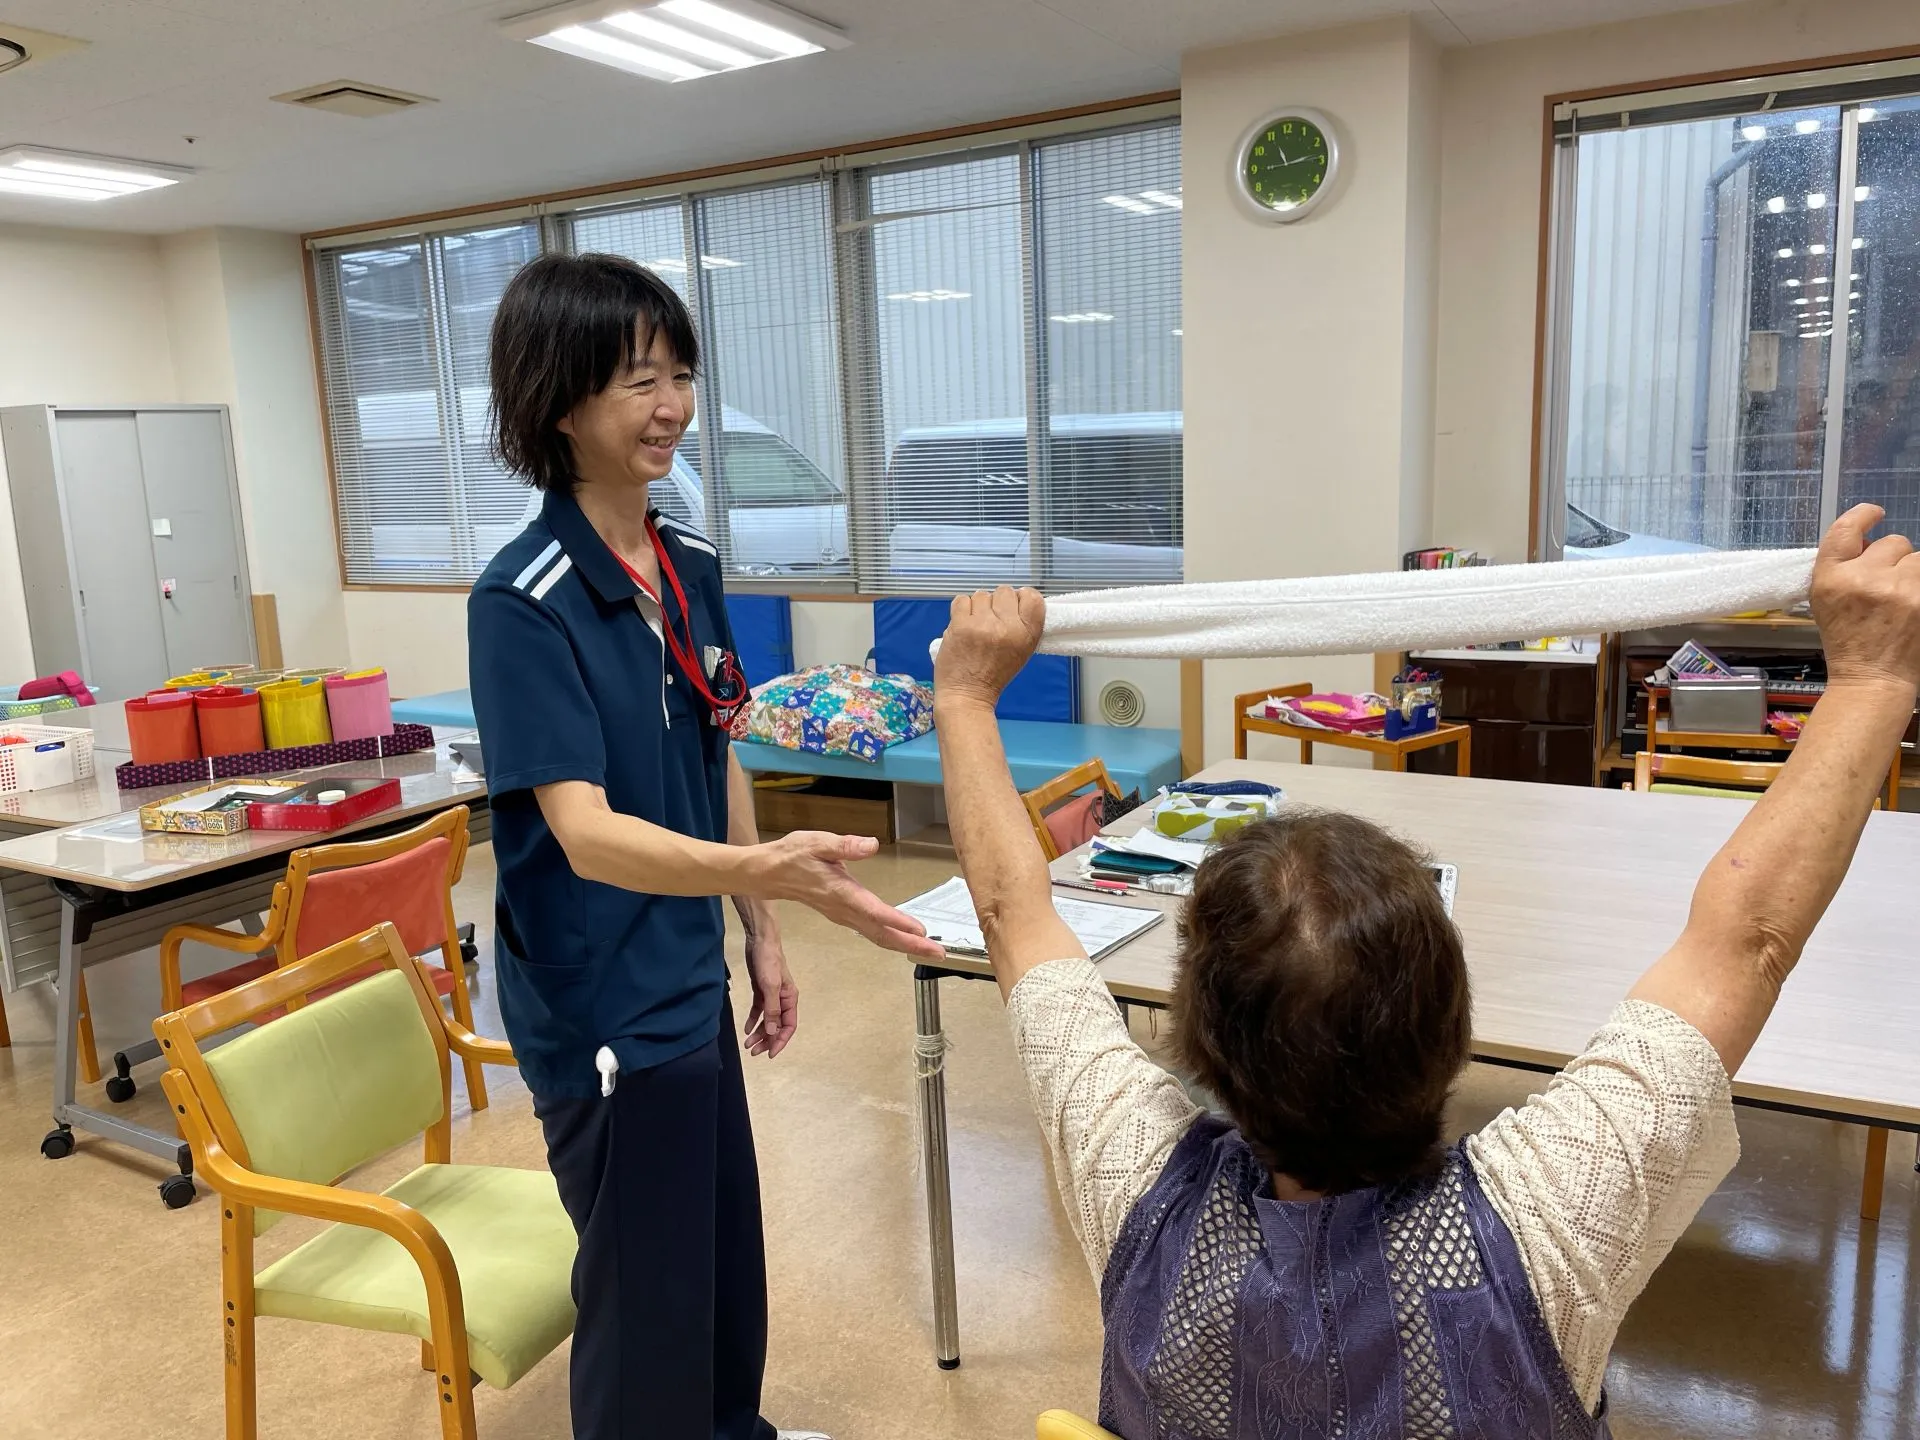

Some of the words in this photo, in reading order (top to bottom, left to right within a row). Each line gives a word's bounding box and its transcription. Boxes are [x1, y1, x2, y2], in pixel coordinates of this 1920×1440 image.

[1283, 124, 1292, 134] 12
[1302, 126, 1306, 136] 1
[1267, 131, 1275, 141] 11
[1314, 137, 1320, 147] 2
[1255, 146, 1265, 156] 10
[1318, 155, 1325, 165] 3
[1251, 165, 1257, 174] 9
[1313, 174, 1320, 184] 4
[1255, 182, 1262, 192] 8
[1268, 193, 1274, 203] 7
[1301, 189, 1307, 201] 5
[207, 822, 223, 830] 1000
